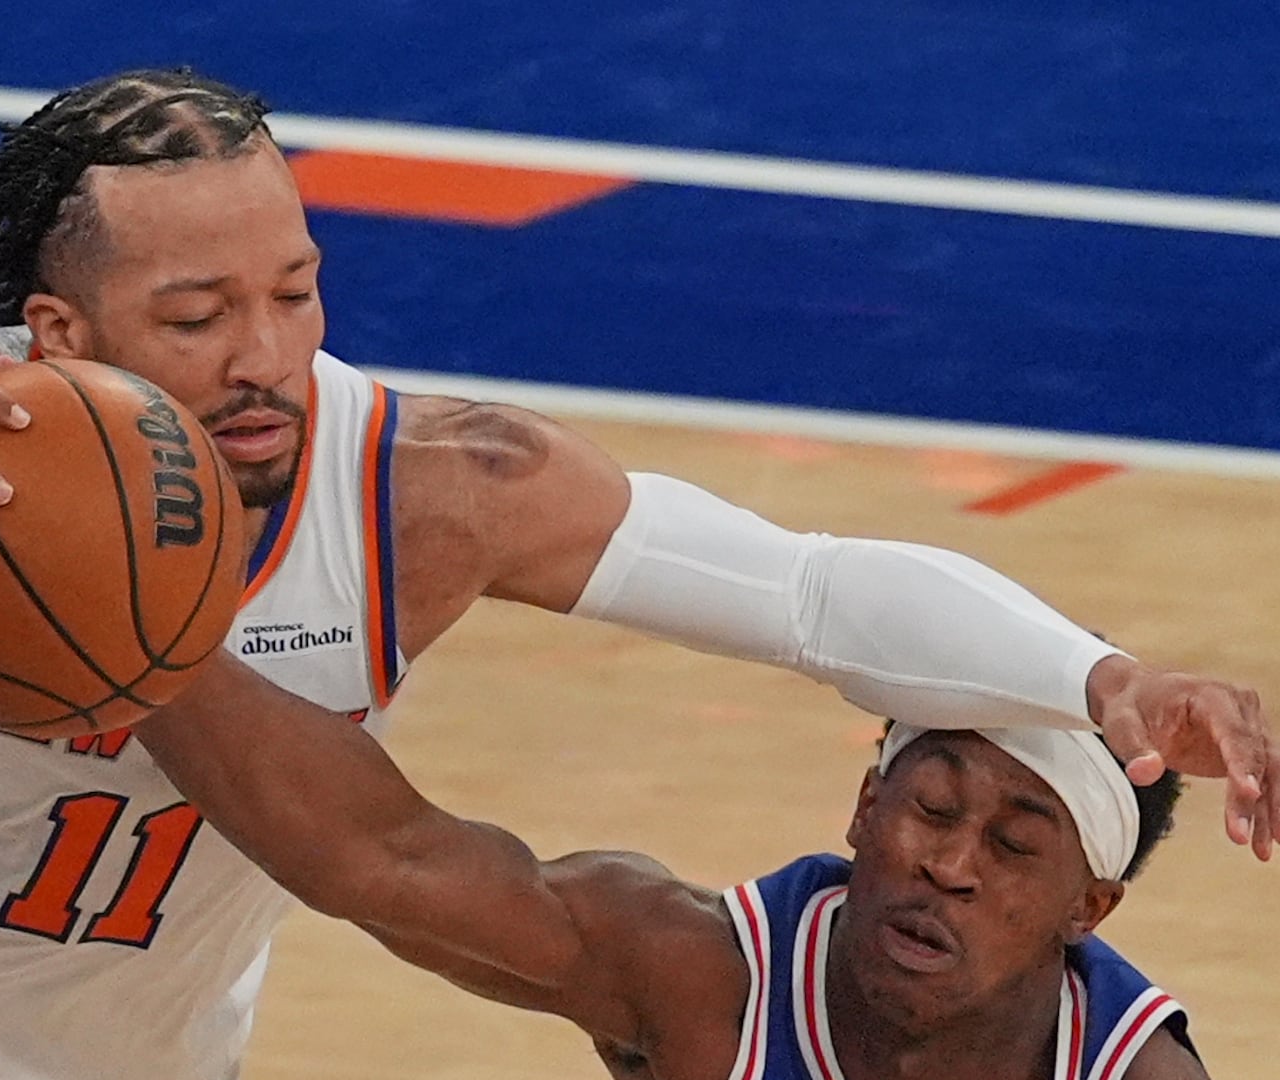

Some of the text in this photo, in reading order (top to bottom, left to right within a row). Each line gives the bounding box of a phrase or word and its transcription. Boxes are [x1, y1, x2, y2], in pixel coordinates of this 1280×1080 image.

[243, 623, 304, 634] experience
[241, 626, 353, 655] abu dhabi
